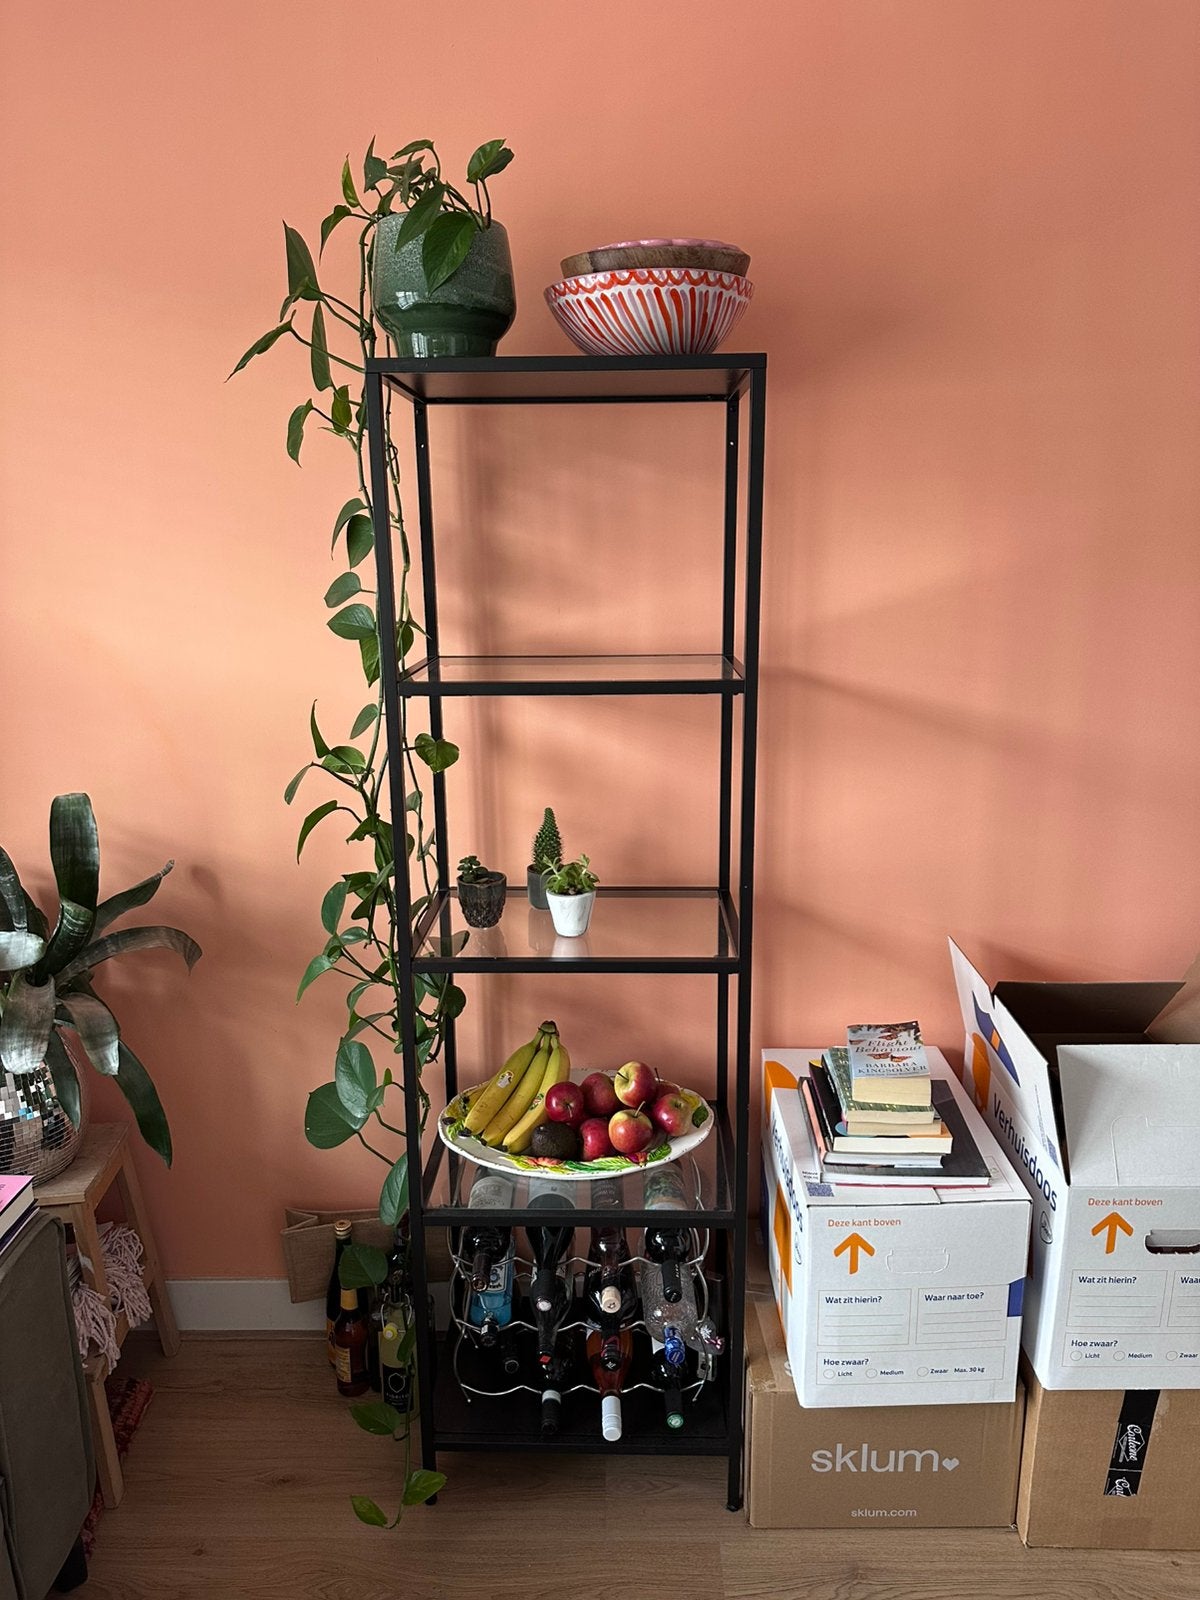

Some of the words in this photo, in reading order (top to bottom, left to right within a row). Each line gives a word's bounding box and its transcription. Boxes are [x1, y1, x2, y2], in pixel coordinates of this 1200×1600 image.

[867, 1040, 908, 1048] Flight
[858, 1065, 927, 1074] KINGSOLVER
[993, 1092, 1058, 1211] Verhuisdoos
[1088, 1198, 1111, 1206] Deze
[1112, 1198, 1133, 1206] kant
[1135, 1198, 1163, 1206] boven
[828, 1219, 850, 1227] Deze
[852, 1218, 872, 1227] kant
[874, 1218, 902, 1226] boven
[1078, 1276, 1095, 1284] Wat
[1097, 1276, 1107, 1284] zit
[1108, 1276, 1137, 1284] hierin?
[825, 1296, 842, 1304] Wat
[843, 1296, 853, 1304] zit
[854, 1296, 882, 1304] hierin?
[924, 1294, 945, 1302] Waar
[966, 1292, 984, 1300] toe?
[823, 1358, 840, 1366] Hoe
[841, 1358, 869, 1366] zwaar?
[811, 1443, 940, 1473] sklum
[851, 1508, 918, 1518] sklum.com
